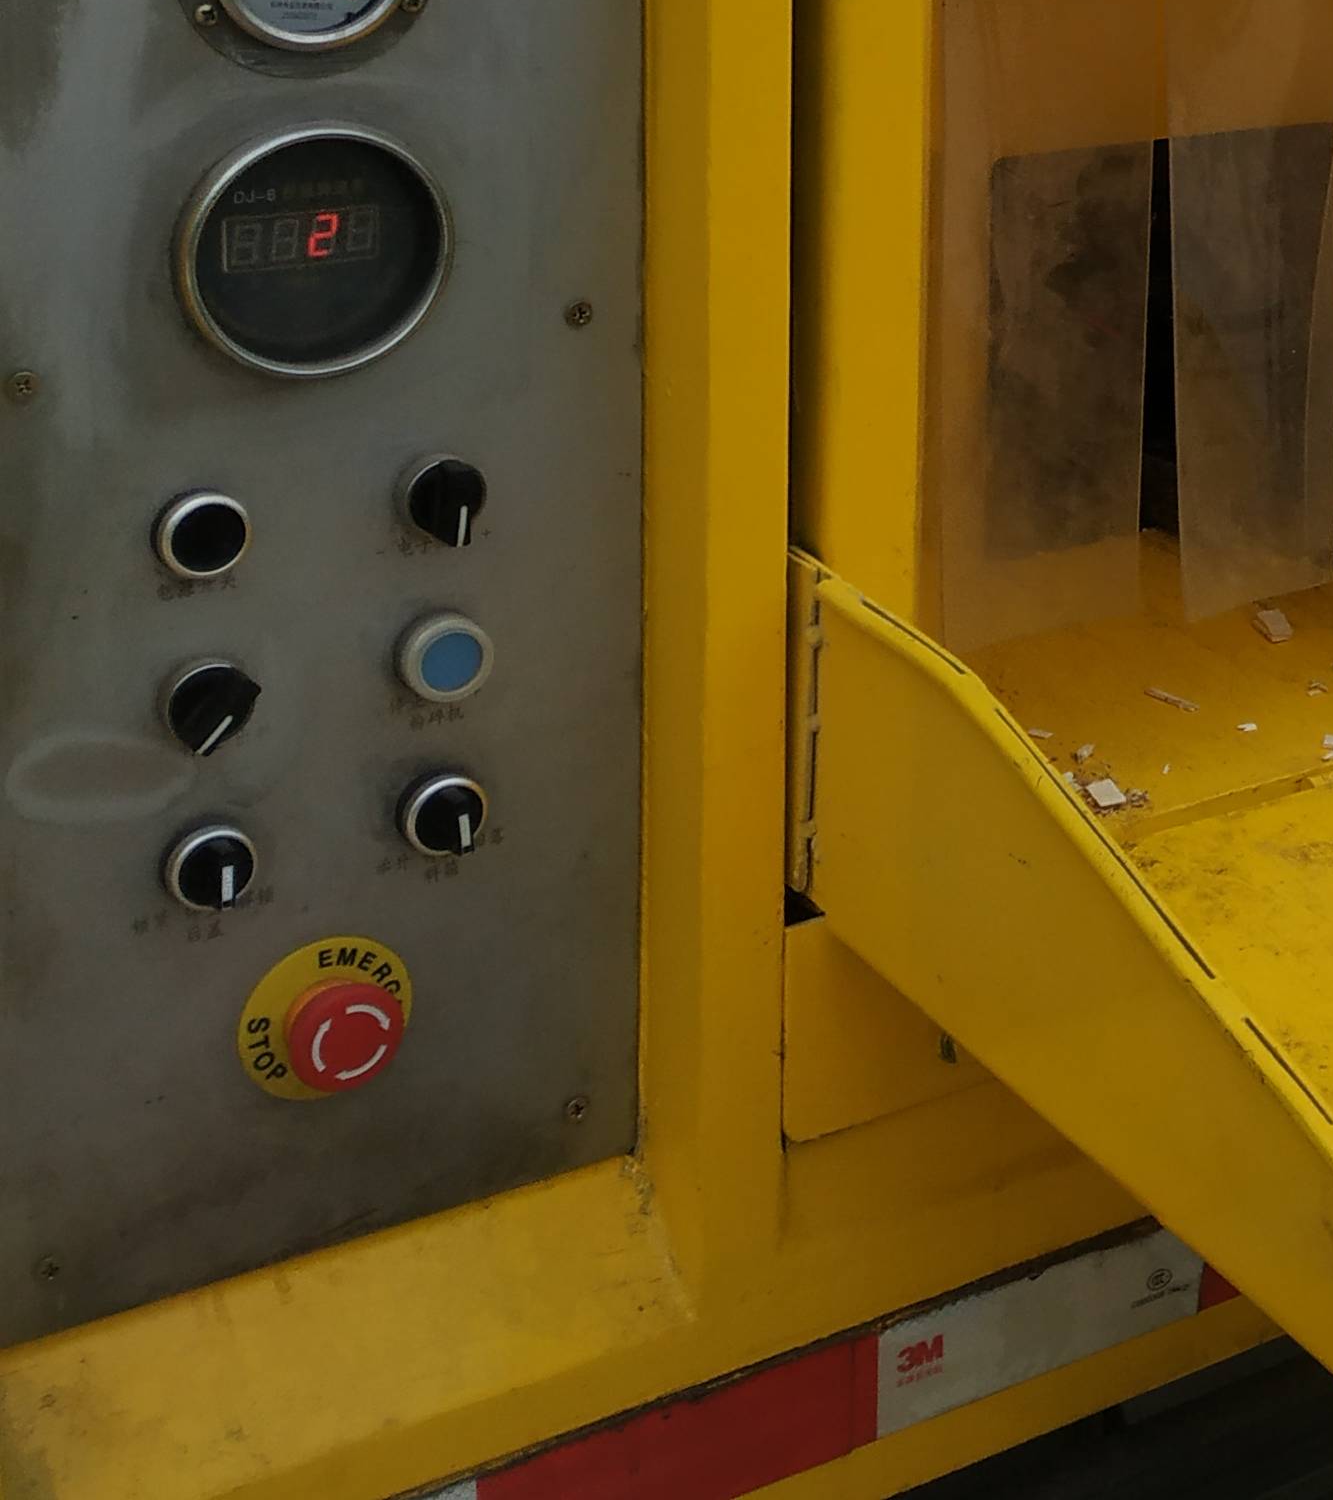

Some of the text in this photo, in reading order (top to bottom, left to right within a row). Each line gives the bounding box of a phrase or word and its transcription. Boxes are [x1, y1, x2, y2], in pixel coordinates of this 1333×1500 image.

[307, 212, 339, 257] 2
[317, 947, 402, 995] EMERG
[247, 1016, 288, 1081] STOP
[897, 1334, 944, 1372] 3M
